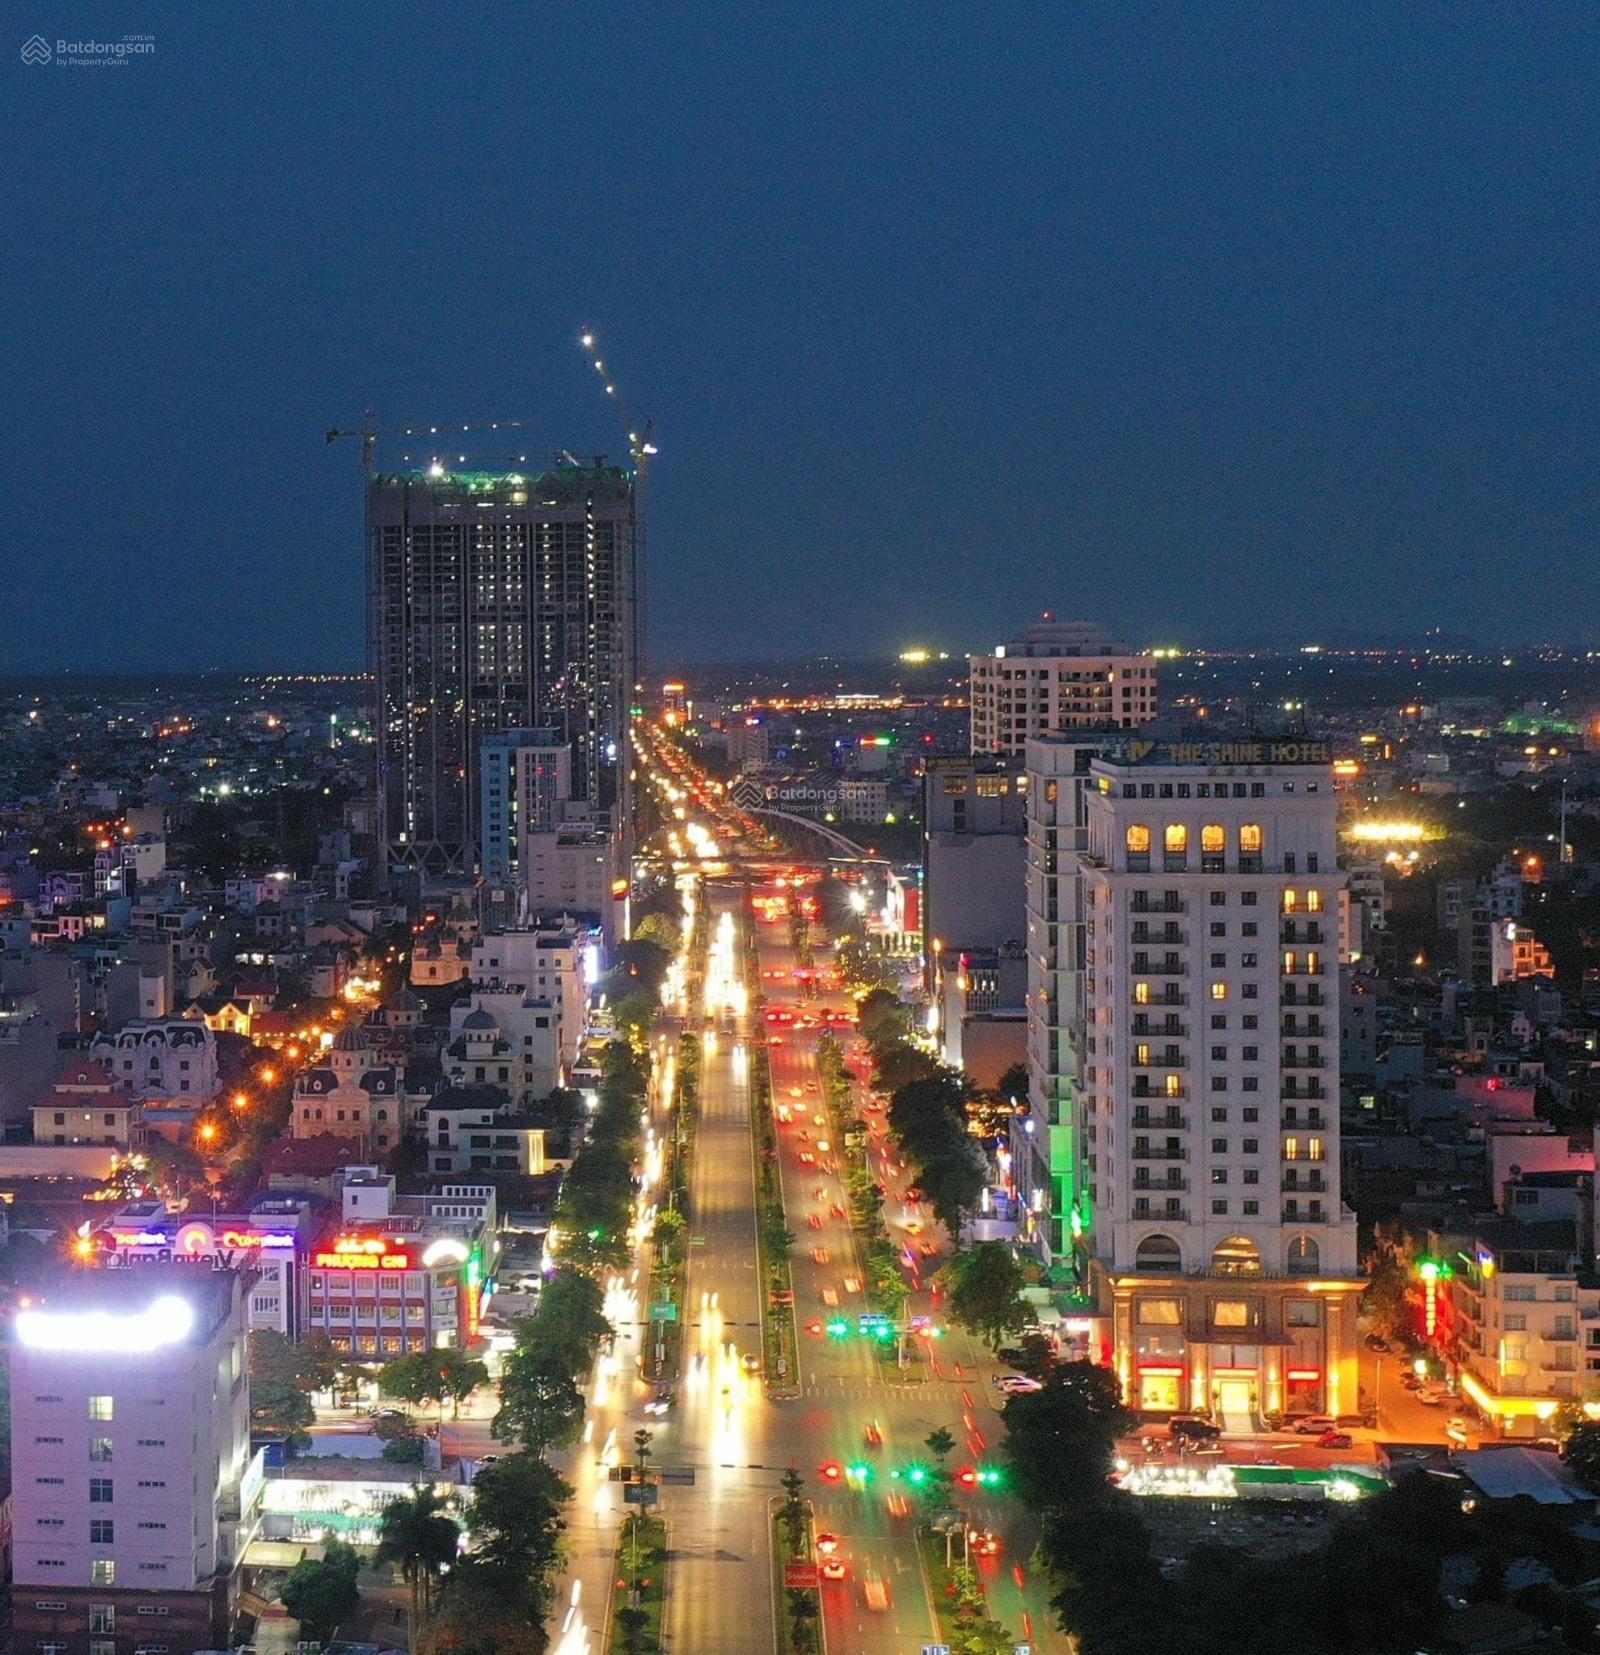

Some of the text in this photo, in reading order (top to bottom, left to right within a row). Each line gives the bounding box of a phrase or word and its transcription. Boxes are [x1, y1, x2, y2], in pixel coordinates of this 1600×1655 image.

[1170, 743, 1331, 761] THE SHINE HOTEL
